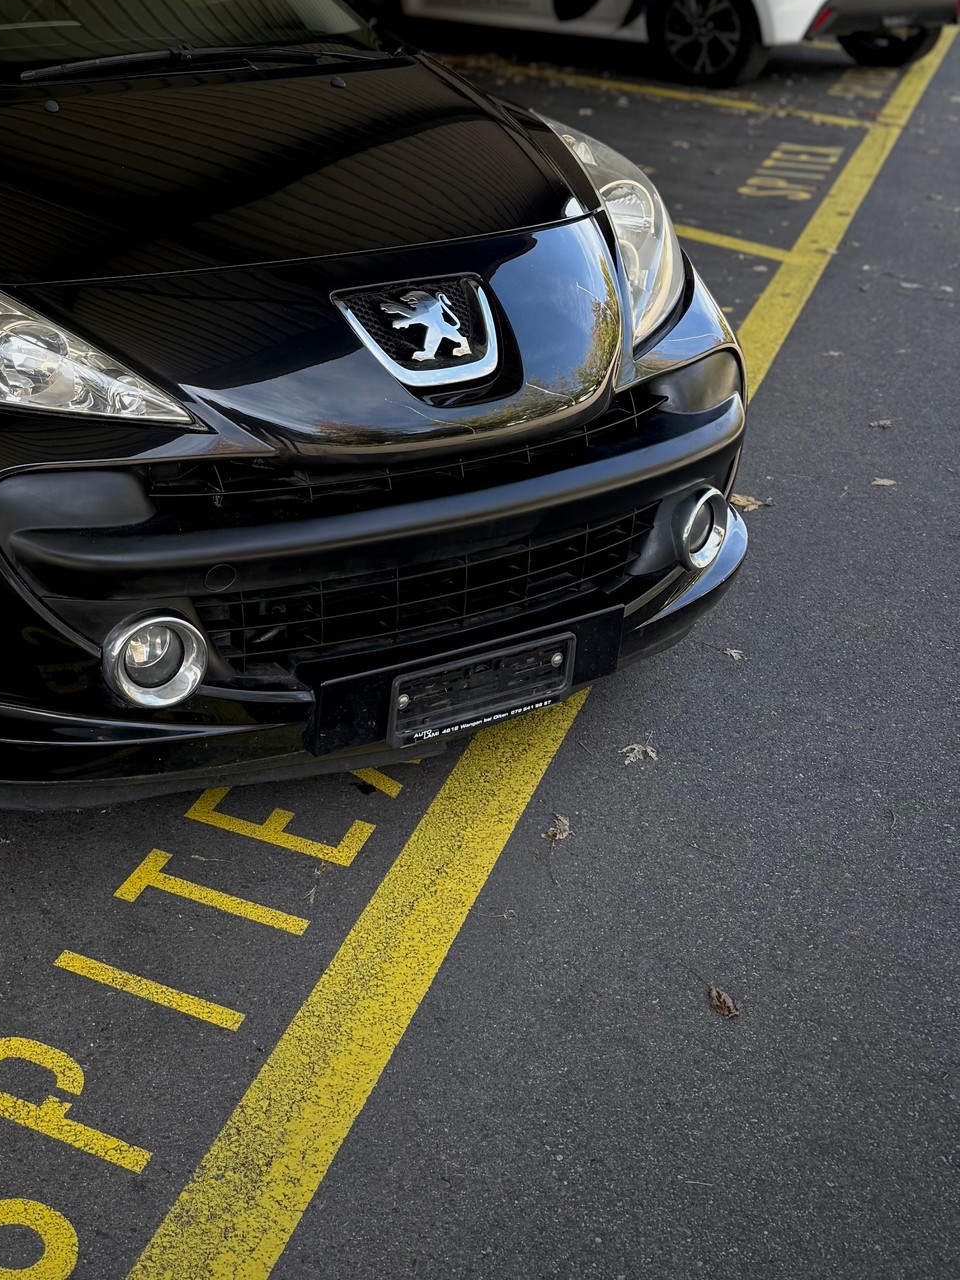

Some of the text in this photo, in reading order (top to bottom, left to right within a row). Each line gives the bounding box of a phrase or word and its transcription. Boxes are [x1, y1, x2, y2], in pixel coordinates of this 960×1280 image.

[737, 142, 845, 200] SPITEX
[460, 719, 482, 729] Wangen
[413, 729, 432, 738] AUTO
